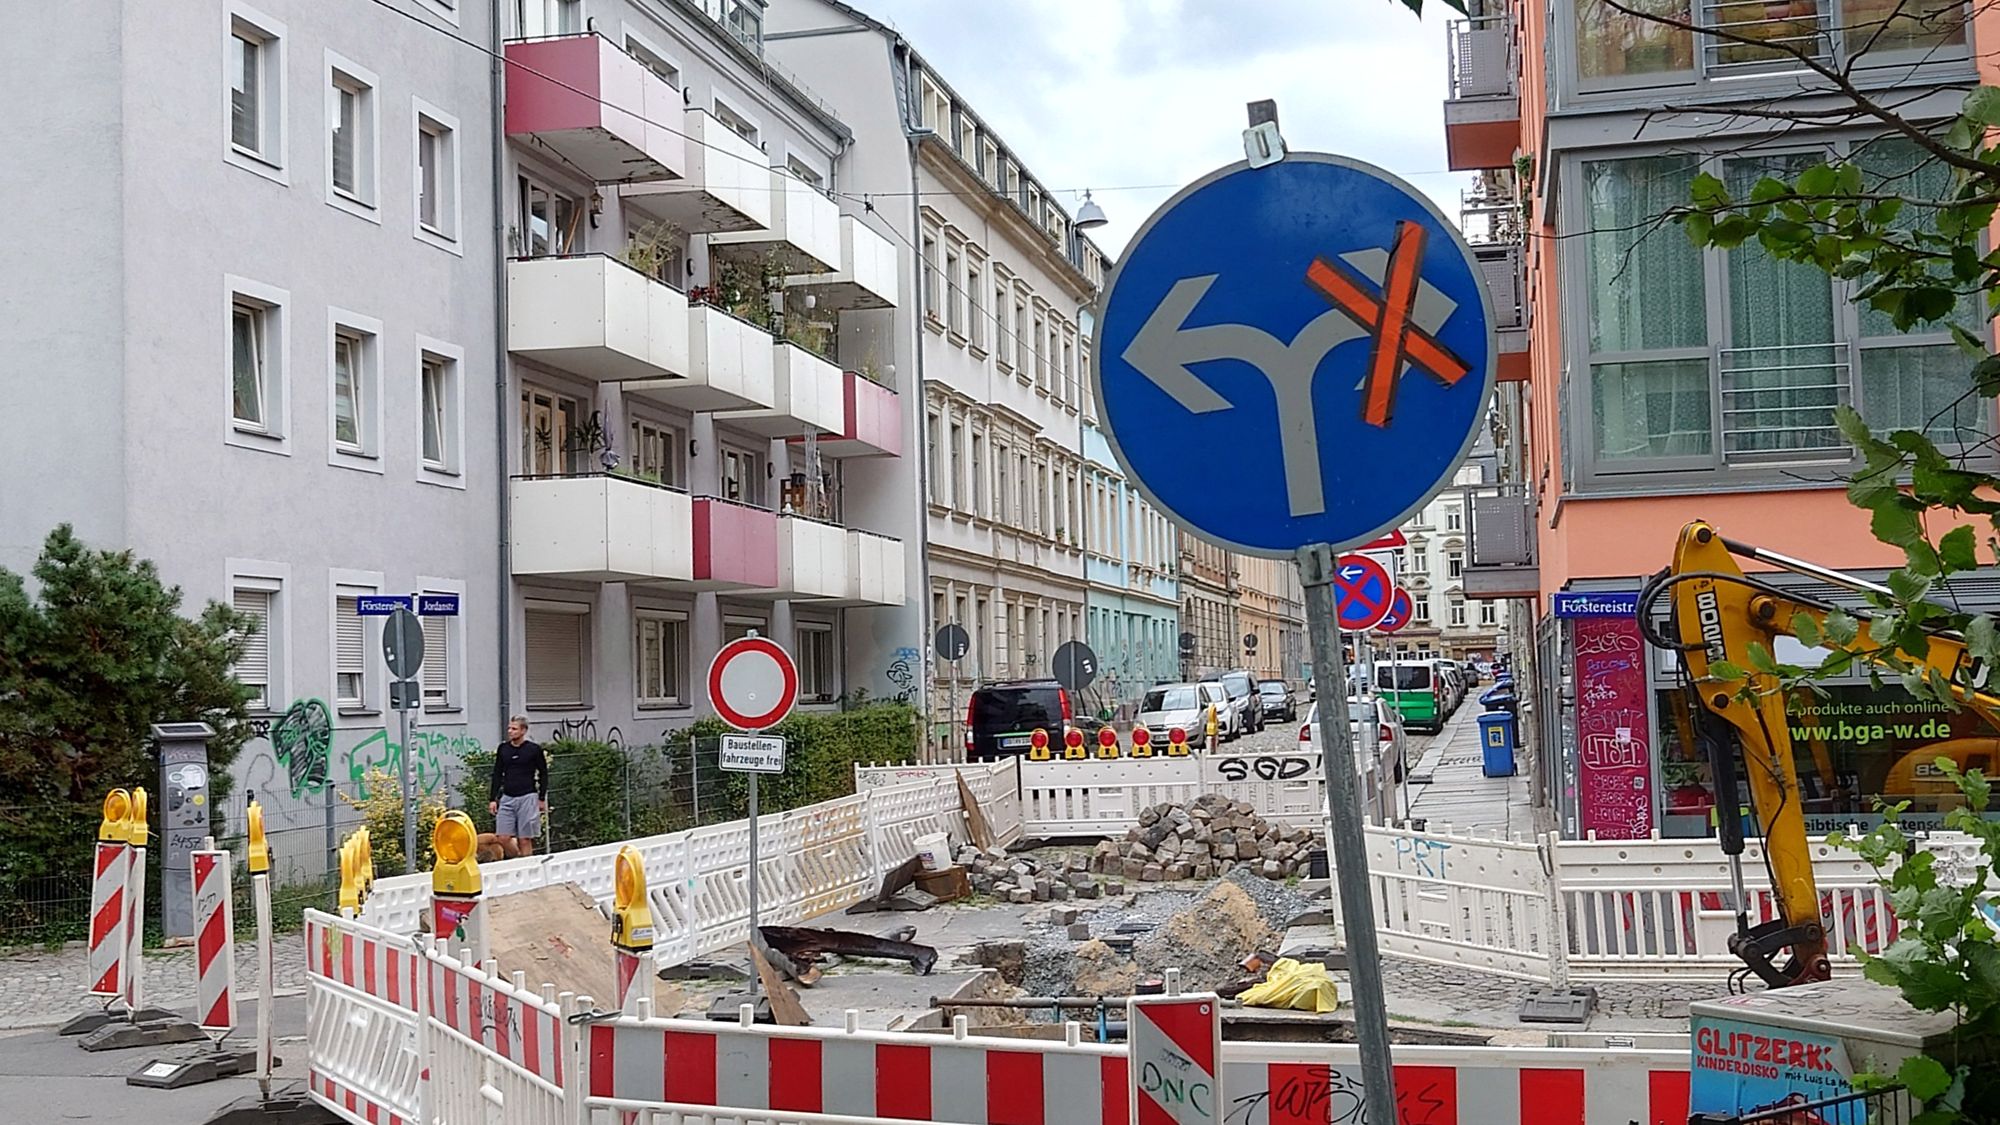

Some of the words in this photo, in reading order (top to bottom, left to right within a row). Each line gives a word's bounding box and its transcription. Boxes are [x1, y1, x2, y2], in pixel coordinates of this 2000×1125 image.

[1561, 599, 1636, 613] Förstereistr.
[1866, 701, 1900, 714] auch
[1904, 700, 1949, 713] online
[1788, 719, 1951, 745] ww.bga-w.de
[728, 739, 777, 751] Baustellen-
[723, 752, 764, 767] fahrzeuge
[767, 755, 782, 766] frei
[1804, 818, 1869, 832] eibtische
[1395, 837, 1452, 880] PRT
[1697, 1027, 1832, 1072] GLITZERK
[1696, 1055, 1779, 1079] KINDERDISKO
[1785, 1071, 1801, 1080] mit
[1804, 1074, 1823, 1085] Luis
[1825, 1077, 1836, 1086] La
[1142, 1061, 1211, 1117] DNC
